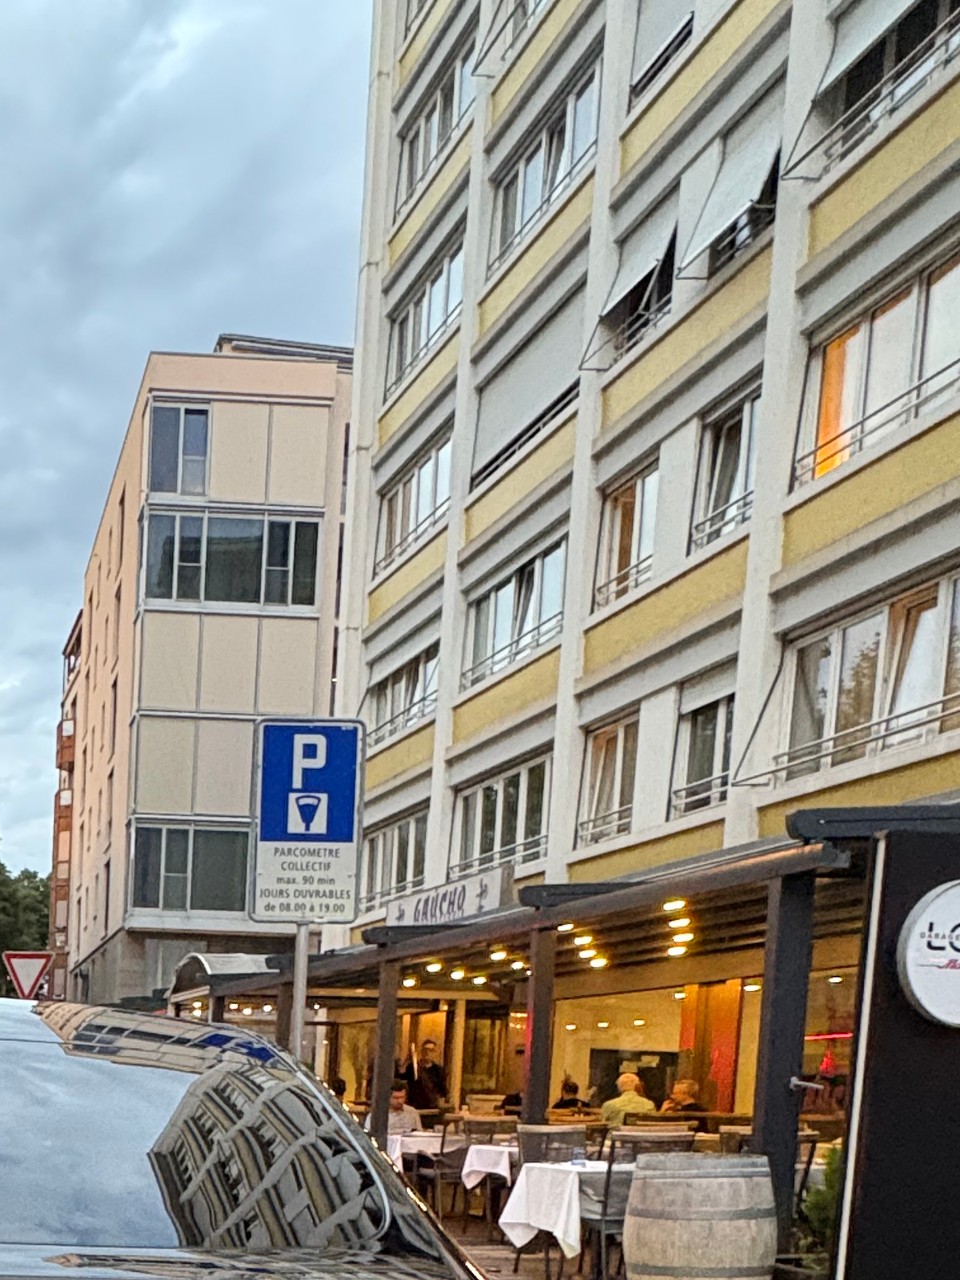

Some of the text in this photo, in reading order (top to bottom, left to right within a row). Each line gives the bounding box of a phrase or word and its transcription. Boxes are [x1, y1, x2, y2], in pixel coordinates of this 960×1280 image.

[292, 733, 327, 789] P
[280, 861, 331, 872] COLLECTIF
[276, 875, 335, 886] max. 90 min
[260, 889, 351, 900] JOURS OUVRABLES
[264, 902, 276, 911] de
[278, 903, 306, 912] 08.00
[319, 903, 345, 913] 19.00
[413, 883, 466, 923] GAUCHO
